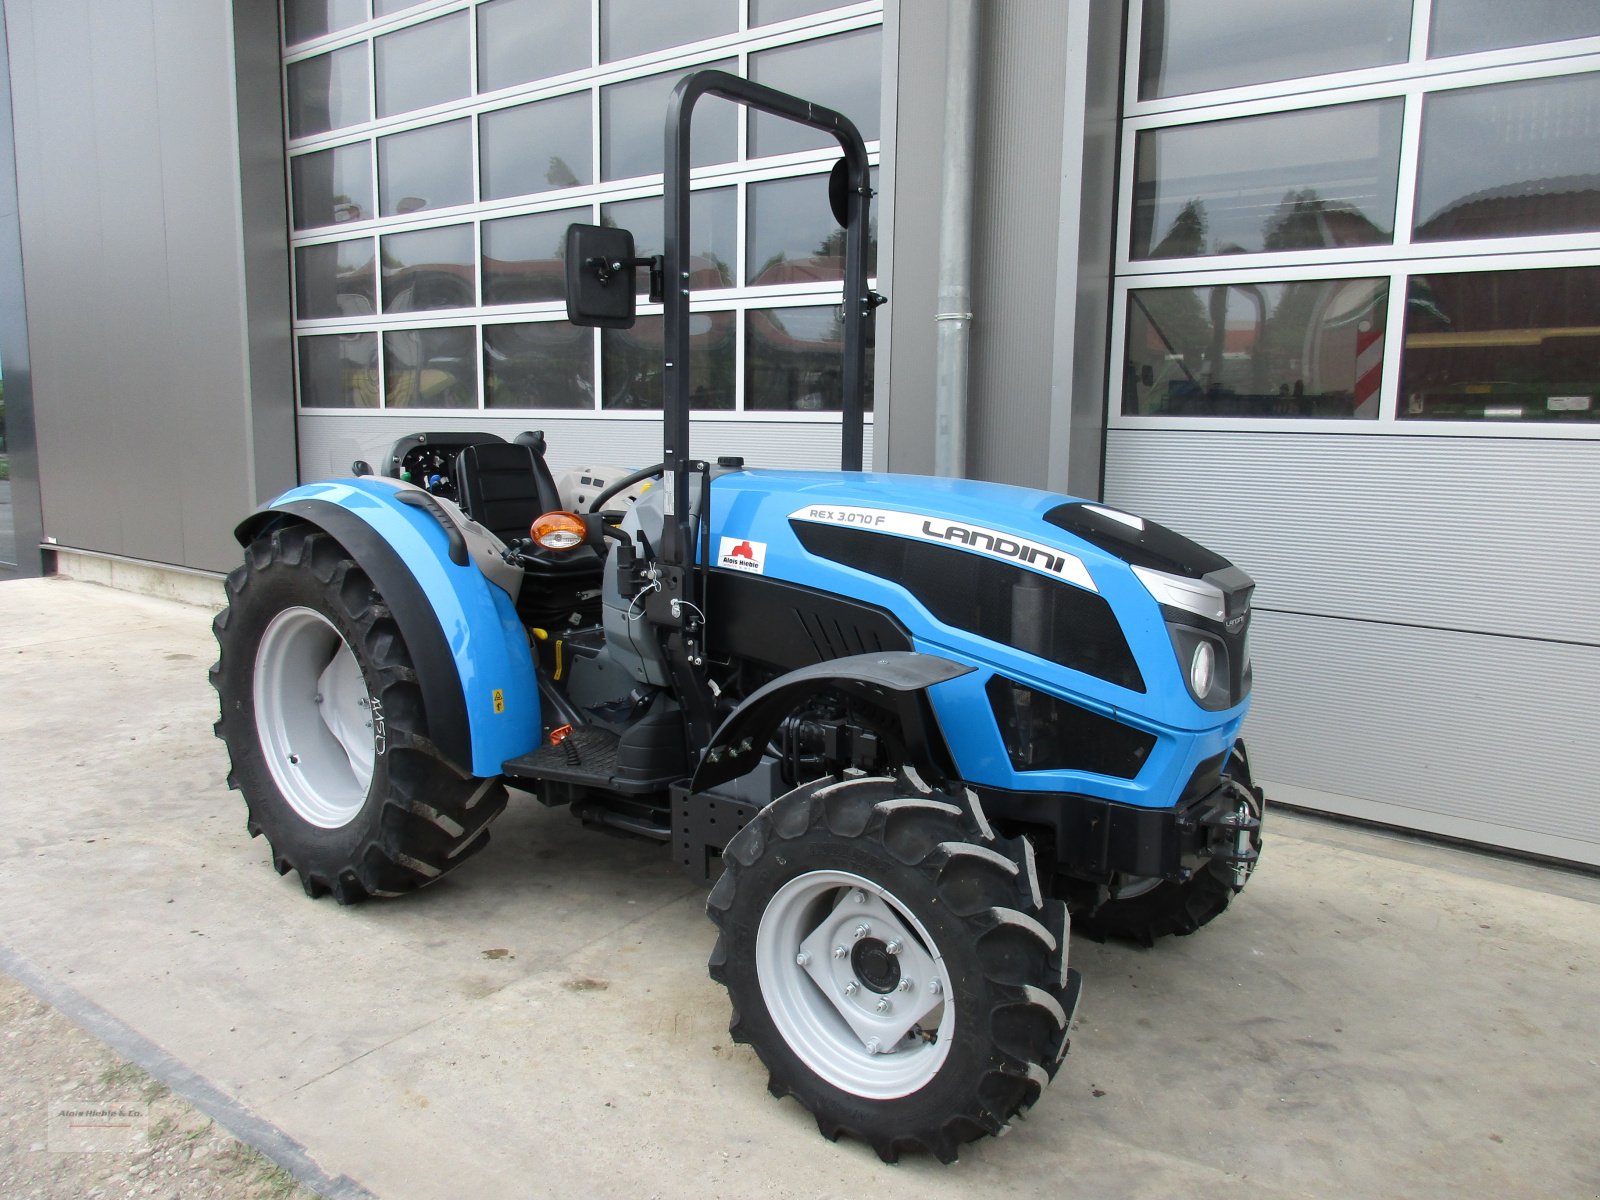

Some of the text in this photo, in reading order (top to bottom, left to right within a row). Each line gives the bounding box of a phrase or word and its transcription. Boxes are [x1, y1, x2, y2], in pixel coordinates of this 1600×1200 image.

[810, 509, 886, 527] REX 3.070 F
[921, 520, 1066, 574] LANDINI
[722, 557, 738, 565] Alois
